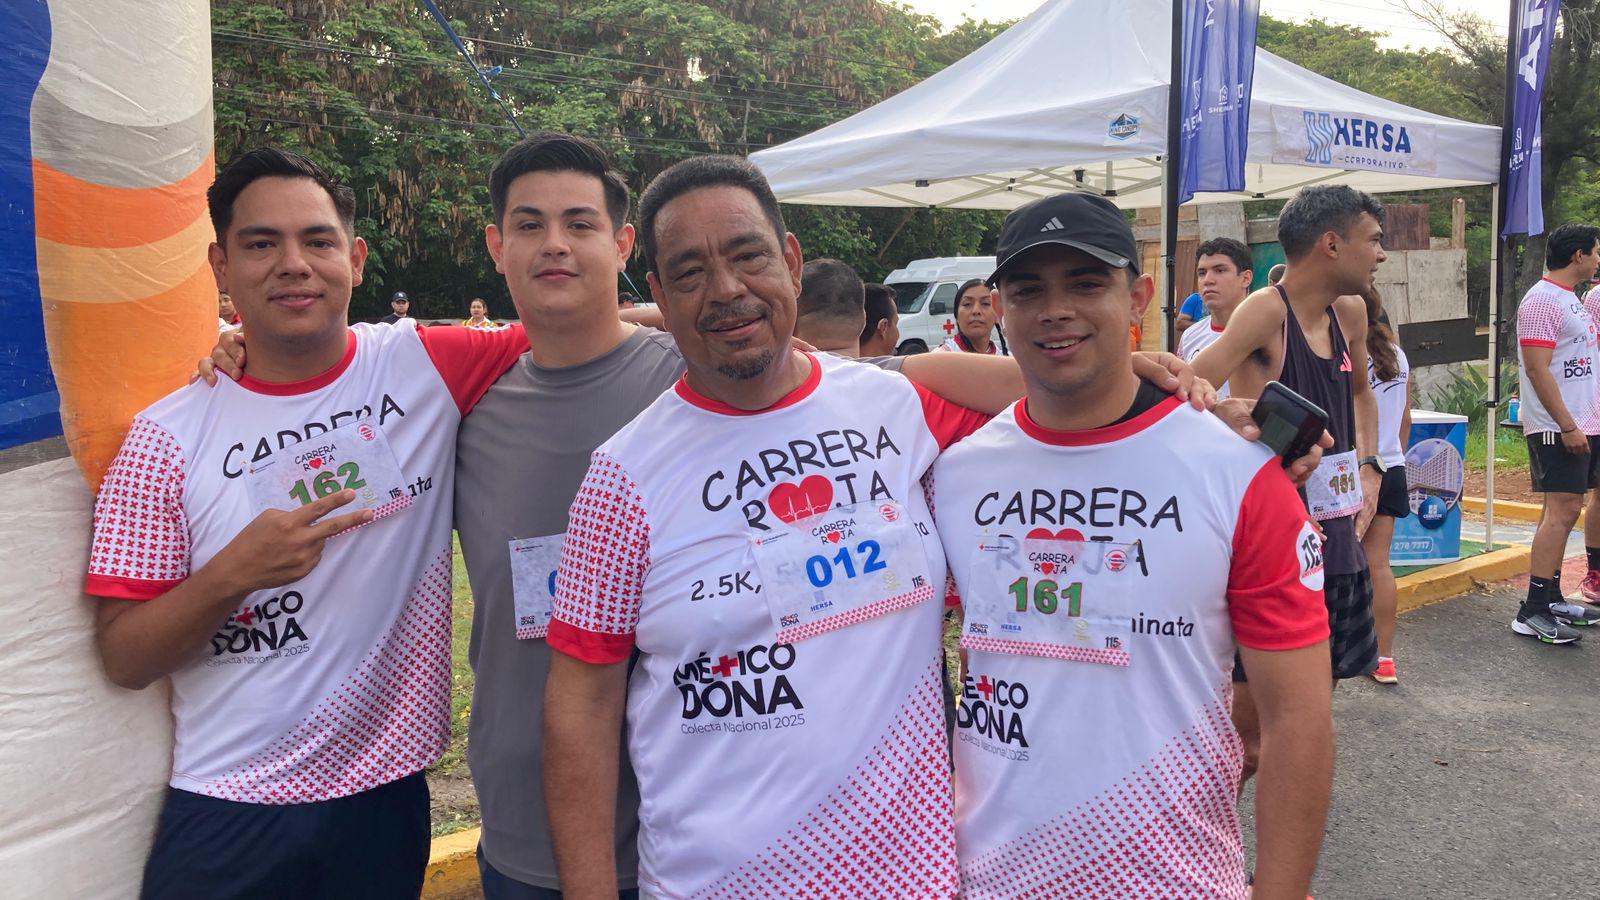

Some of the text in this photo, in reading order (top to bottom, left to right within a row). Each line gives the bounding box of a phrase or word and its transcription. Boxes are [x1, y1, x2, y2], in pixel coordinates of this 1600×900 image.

[1333, 117, 1412, 154] HERSA
[294, 443, 337, 465] CARRERA
[701, 425, 901, 512] CARRERA
[288, 461, 367, 505] 162
[811, 517, 857, 538] CARRERA
[974, 486, 1183, 533] CARRERA
[805, 539, 888, 589] 012
[1028, 551, 1075, 565] CARRERA
[810, 600, 833, 612] HERSA
[1008, 575, 1083, 618] 161
[210, 616, 309, 656] DONA
[1000, 623, 1022, 632] HERSA
[1104, 636, 1119, 648] 115
[284, 642, 310, 658] 2025
[678, 674, 804, 720] DONA
[680, 713, 806, 735] Colecta Nacional 2025
[957, 699, 1030, 748] DONA
